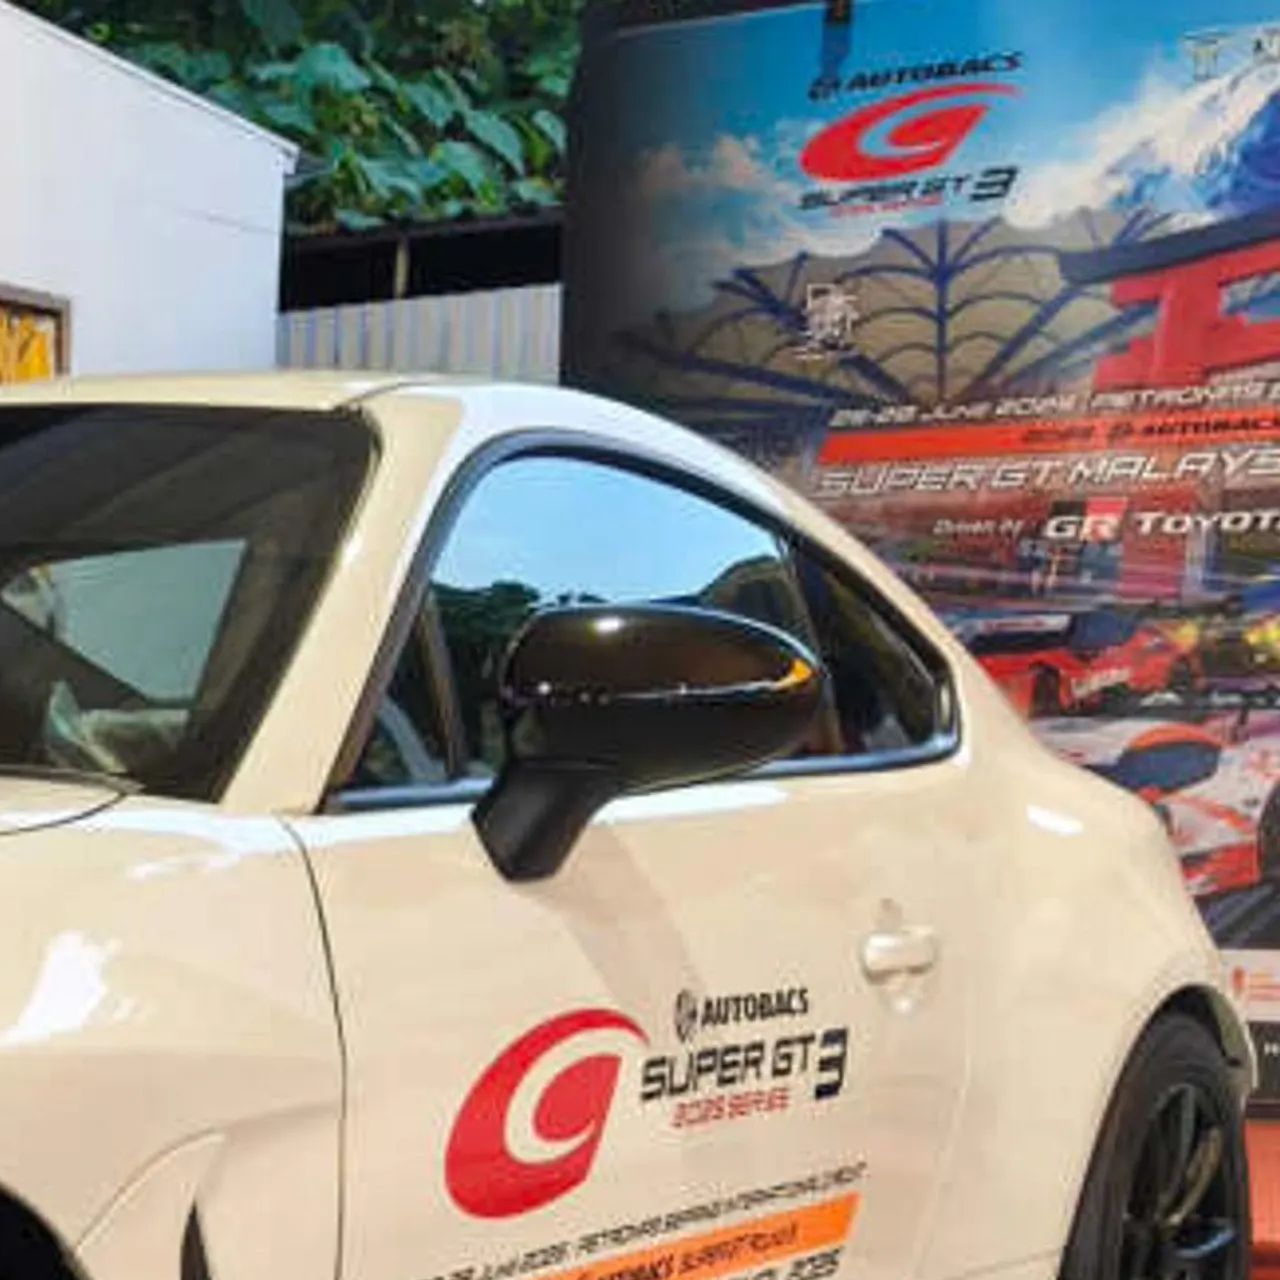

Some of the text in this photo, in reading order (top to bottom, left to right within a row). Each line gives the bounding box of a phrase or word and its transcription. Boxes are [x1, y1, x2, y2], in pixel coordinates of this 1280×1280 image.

[820, 463, 987, 494] SUPER
[990, 459, 1065, 487] GT
[1044, 515, 1122, 542] GR
[1136, 508, 1280, 537] TOYOT
[701, 988, 809, 1027] AUTOBACS
[640, 1027, 848, 1102] SUPER GT 3
